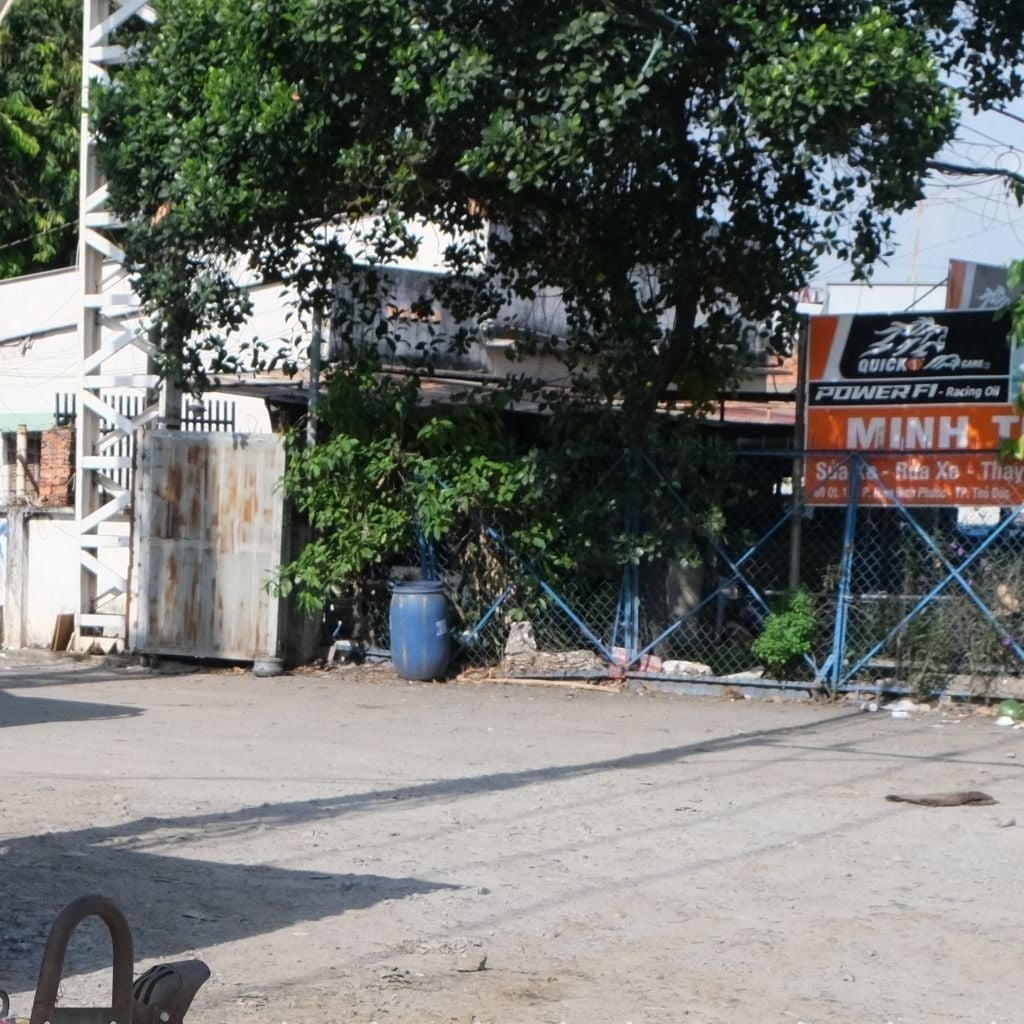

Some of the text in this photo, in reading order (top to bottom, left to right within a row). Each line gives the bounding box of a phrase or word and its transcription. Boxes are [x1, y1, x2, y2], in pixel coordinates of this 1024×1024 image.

[946, 386, 982, 399] Racing
[985, 386, 1001, 397] Oil
[847, 415, 969, 449] MINH
[936, 461, 959, 480] Xe
